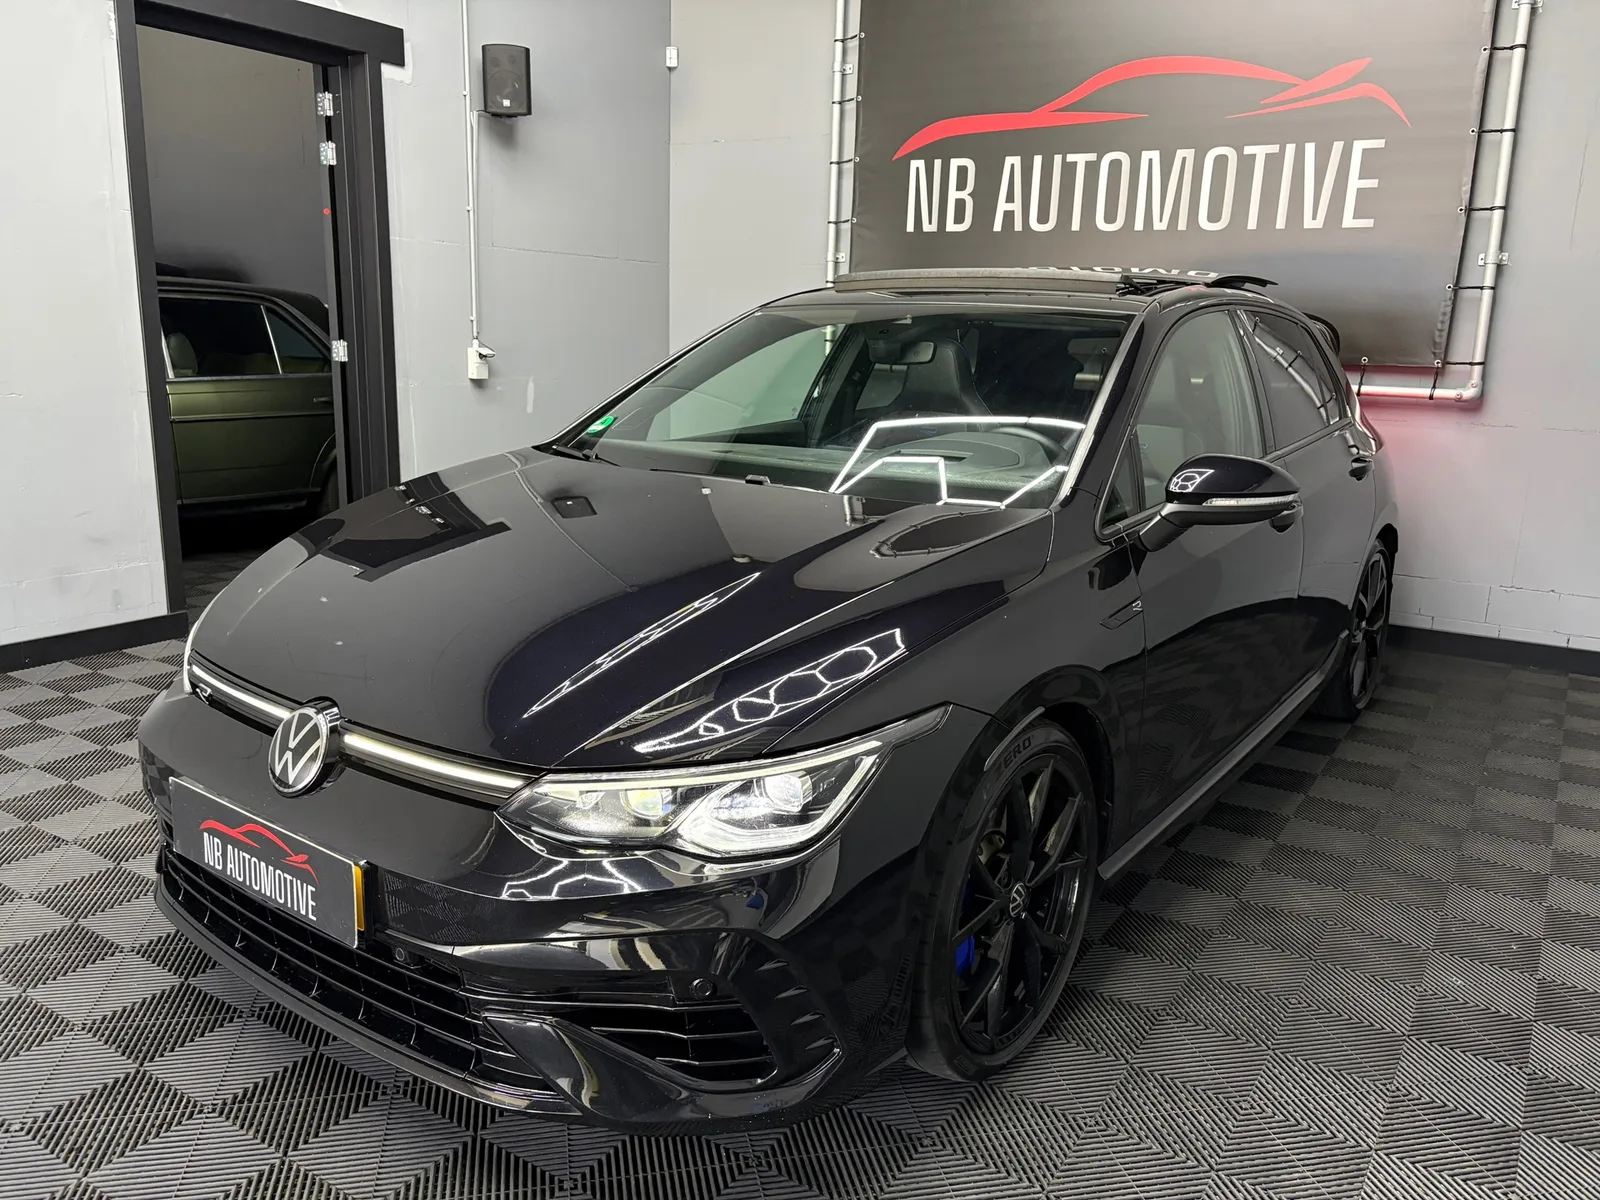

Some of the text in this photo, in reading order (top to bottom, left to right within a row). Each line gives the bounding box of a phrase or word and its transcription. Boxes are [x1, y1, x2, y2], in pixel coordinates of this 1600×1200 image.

[906, 139, 1386, 233] NB AUTOMOTIVE
[203, 831, 317, 922] NB AUTOMOTIVE
